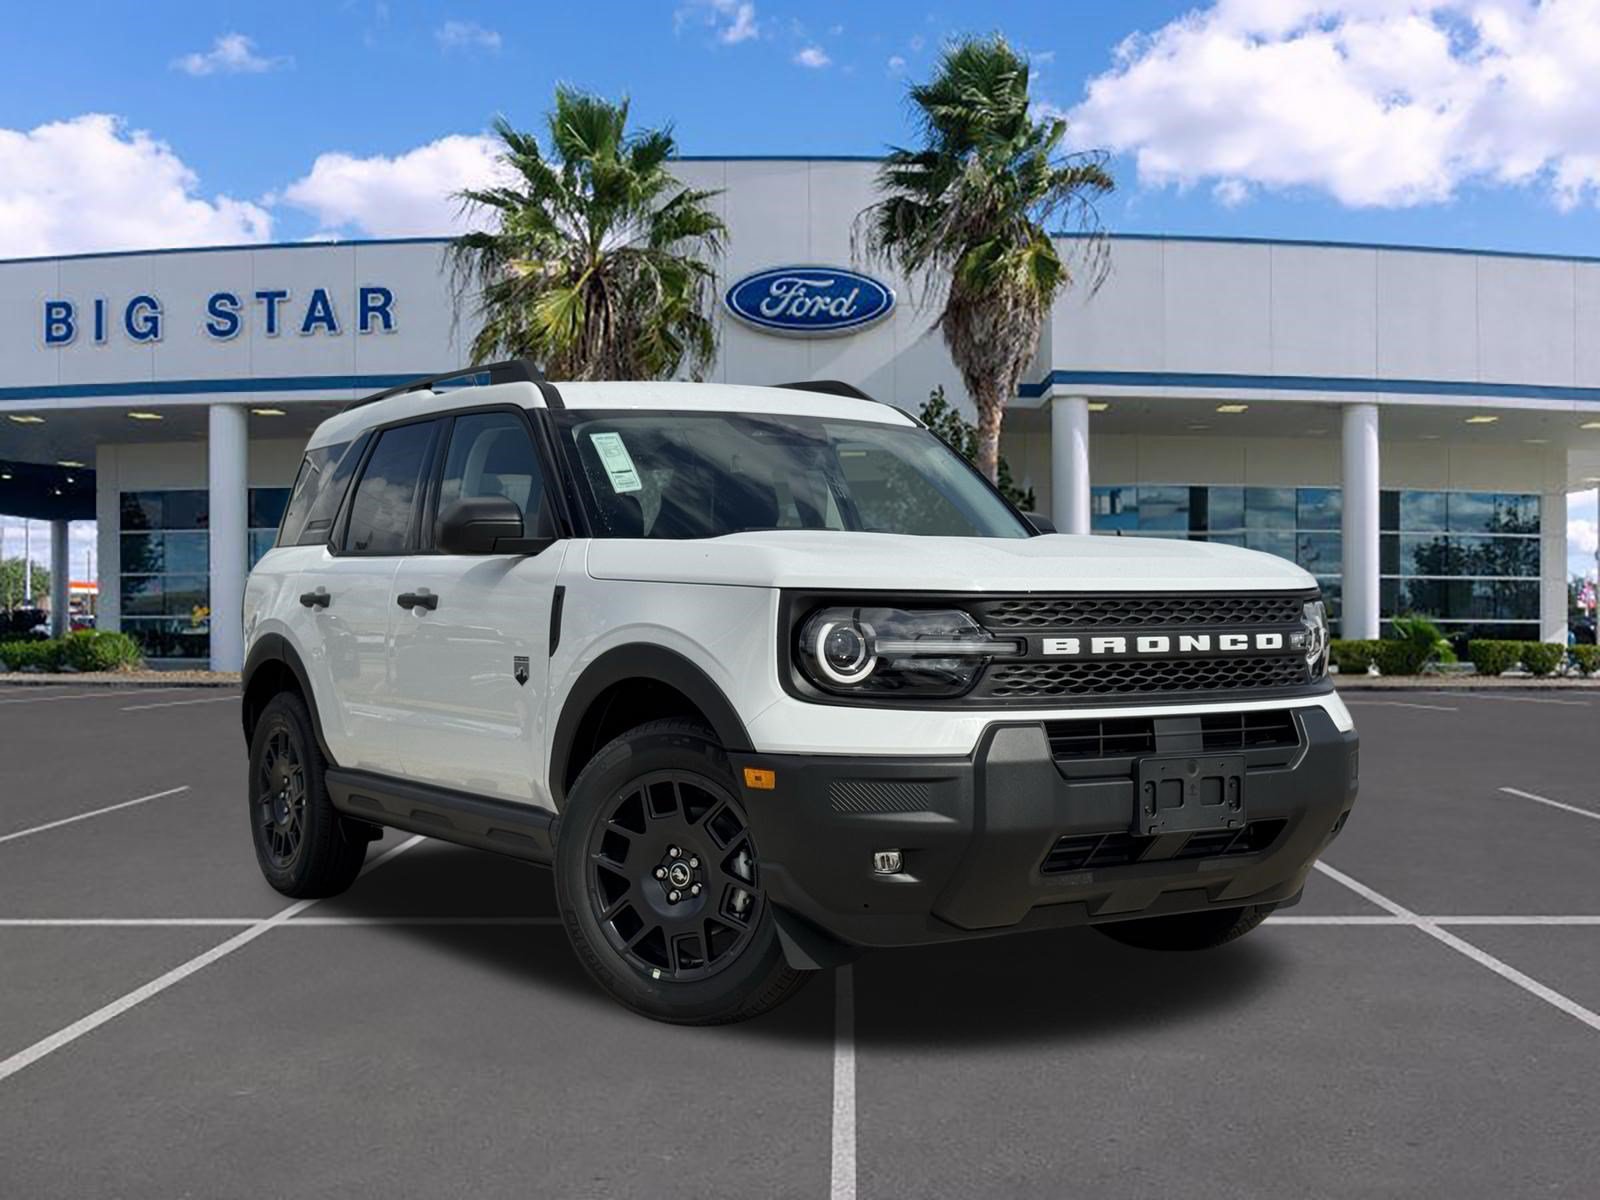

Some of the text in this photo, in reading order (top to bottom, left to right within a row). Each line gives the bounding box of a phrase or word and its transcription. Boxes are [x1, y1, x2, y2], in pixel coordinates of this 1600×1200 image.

[44, 286, 397, 346] BIG STAR
[759, 277, 858, 318] Ford
[1042, 633, 1283, 655] BRONCO
